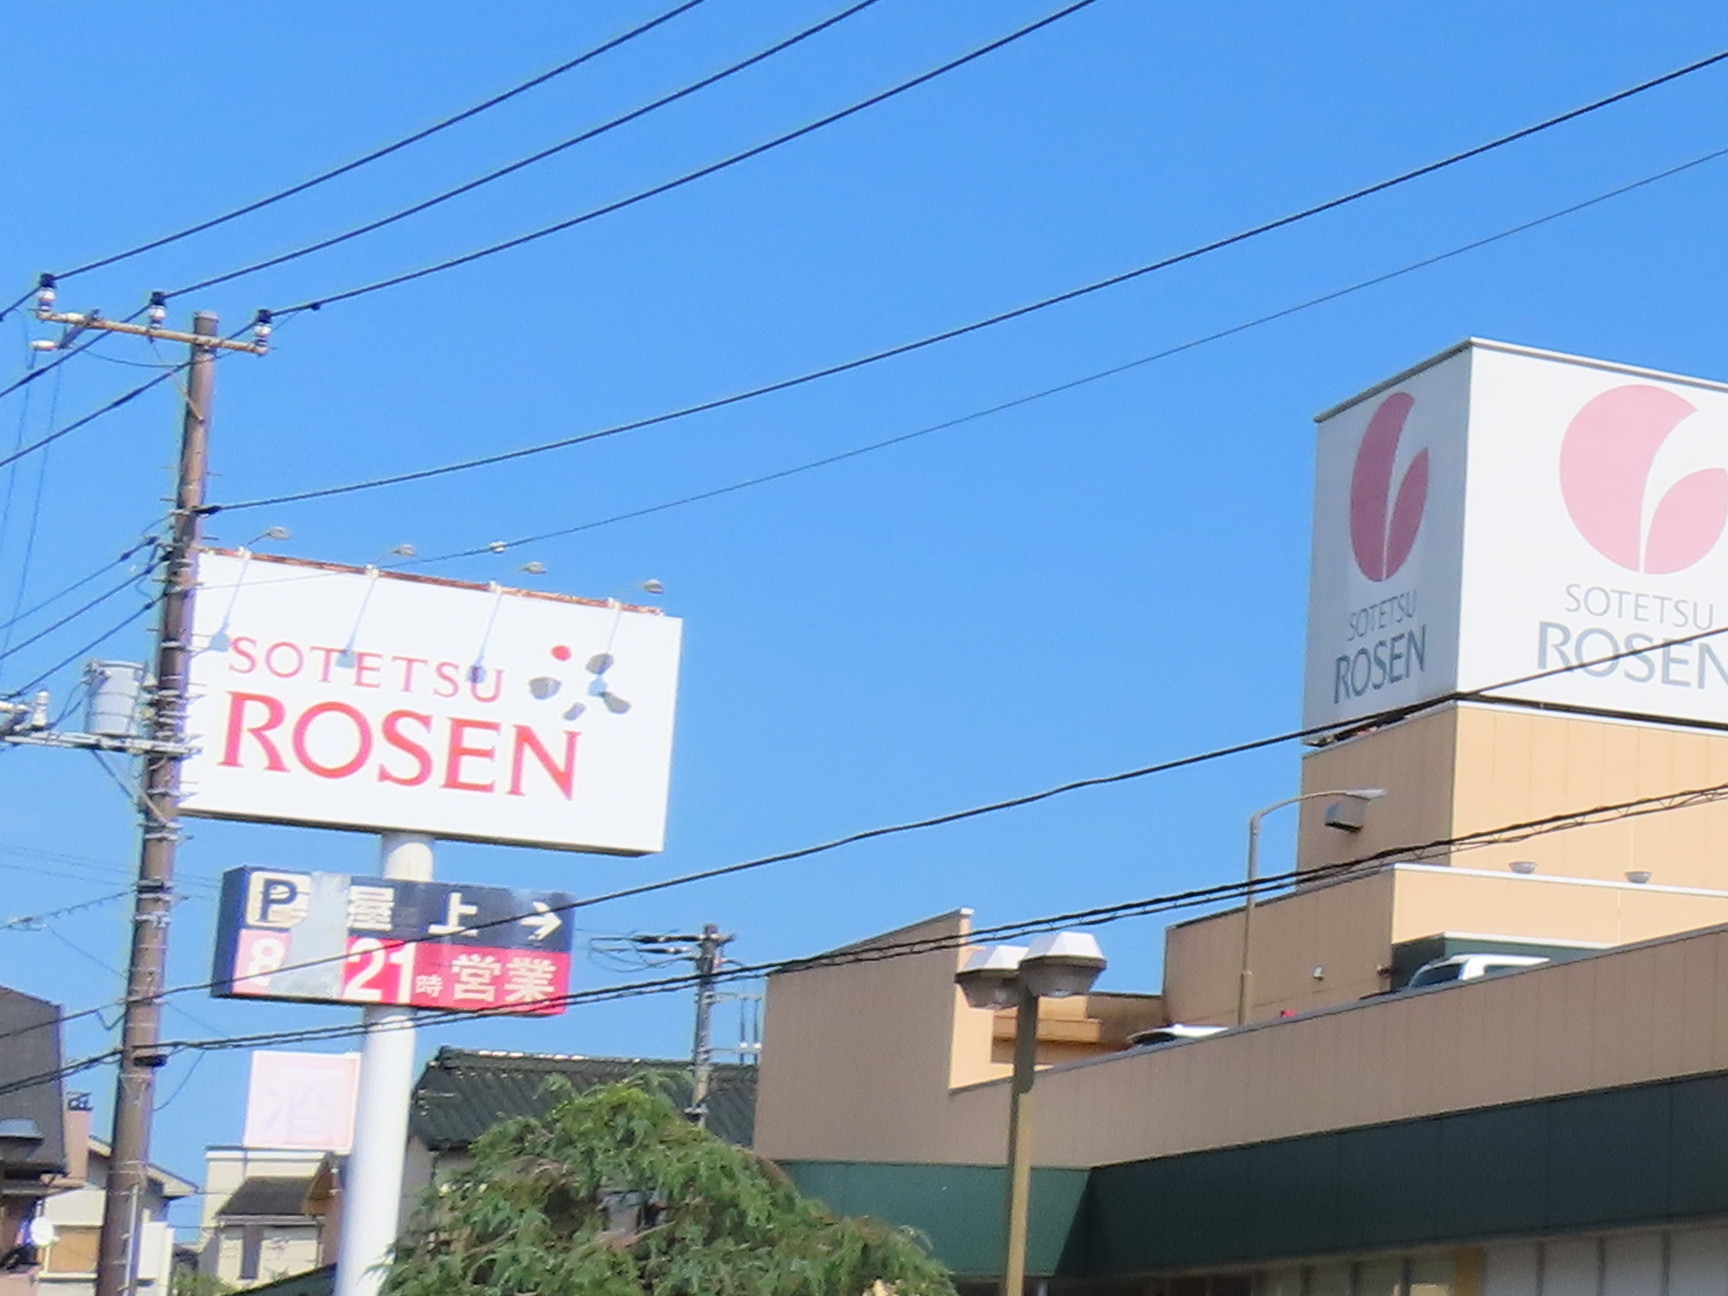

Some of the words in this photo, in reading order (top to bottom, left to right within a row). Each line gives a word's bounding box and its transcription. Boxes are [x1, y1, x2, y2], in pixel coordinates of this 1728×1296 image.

[1347, 588, 1418, 642] SOTETSU
[1564, 583, 1715, 629] SOTETSU
[228, 635, 505, 703] SOTETSU
[1334, 624, 1428, 705] ROSEN
[217, 691, 582, 800] ROSEN
[261, 878, 298, 924] P
